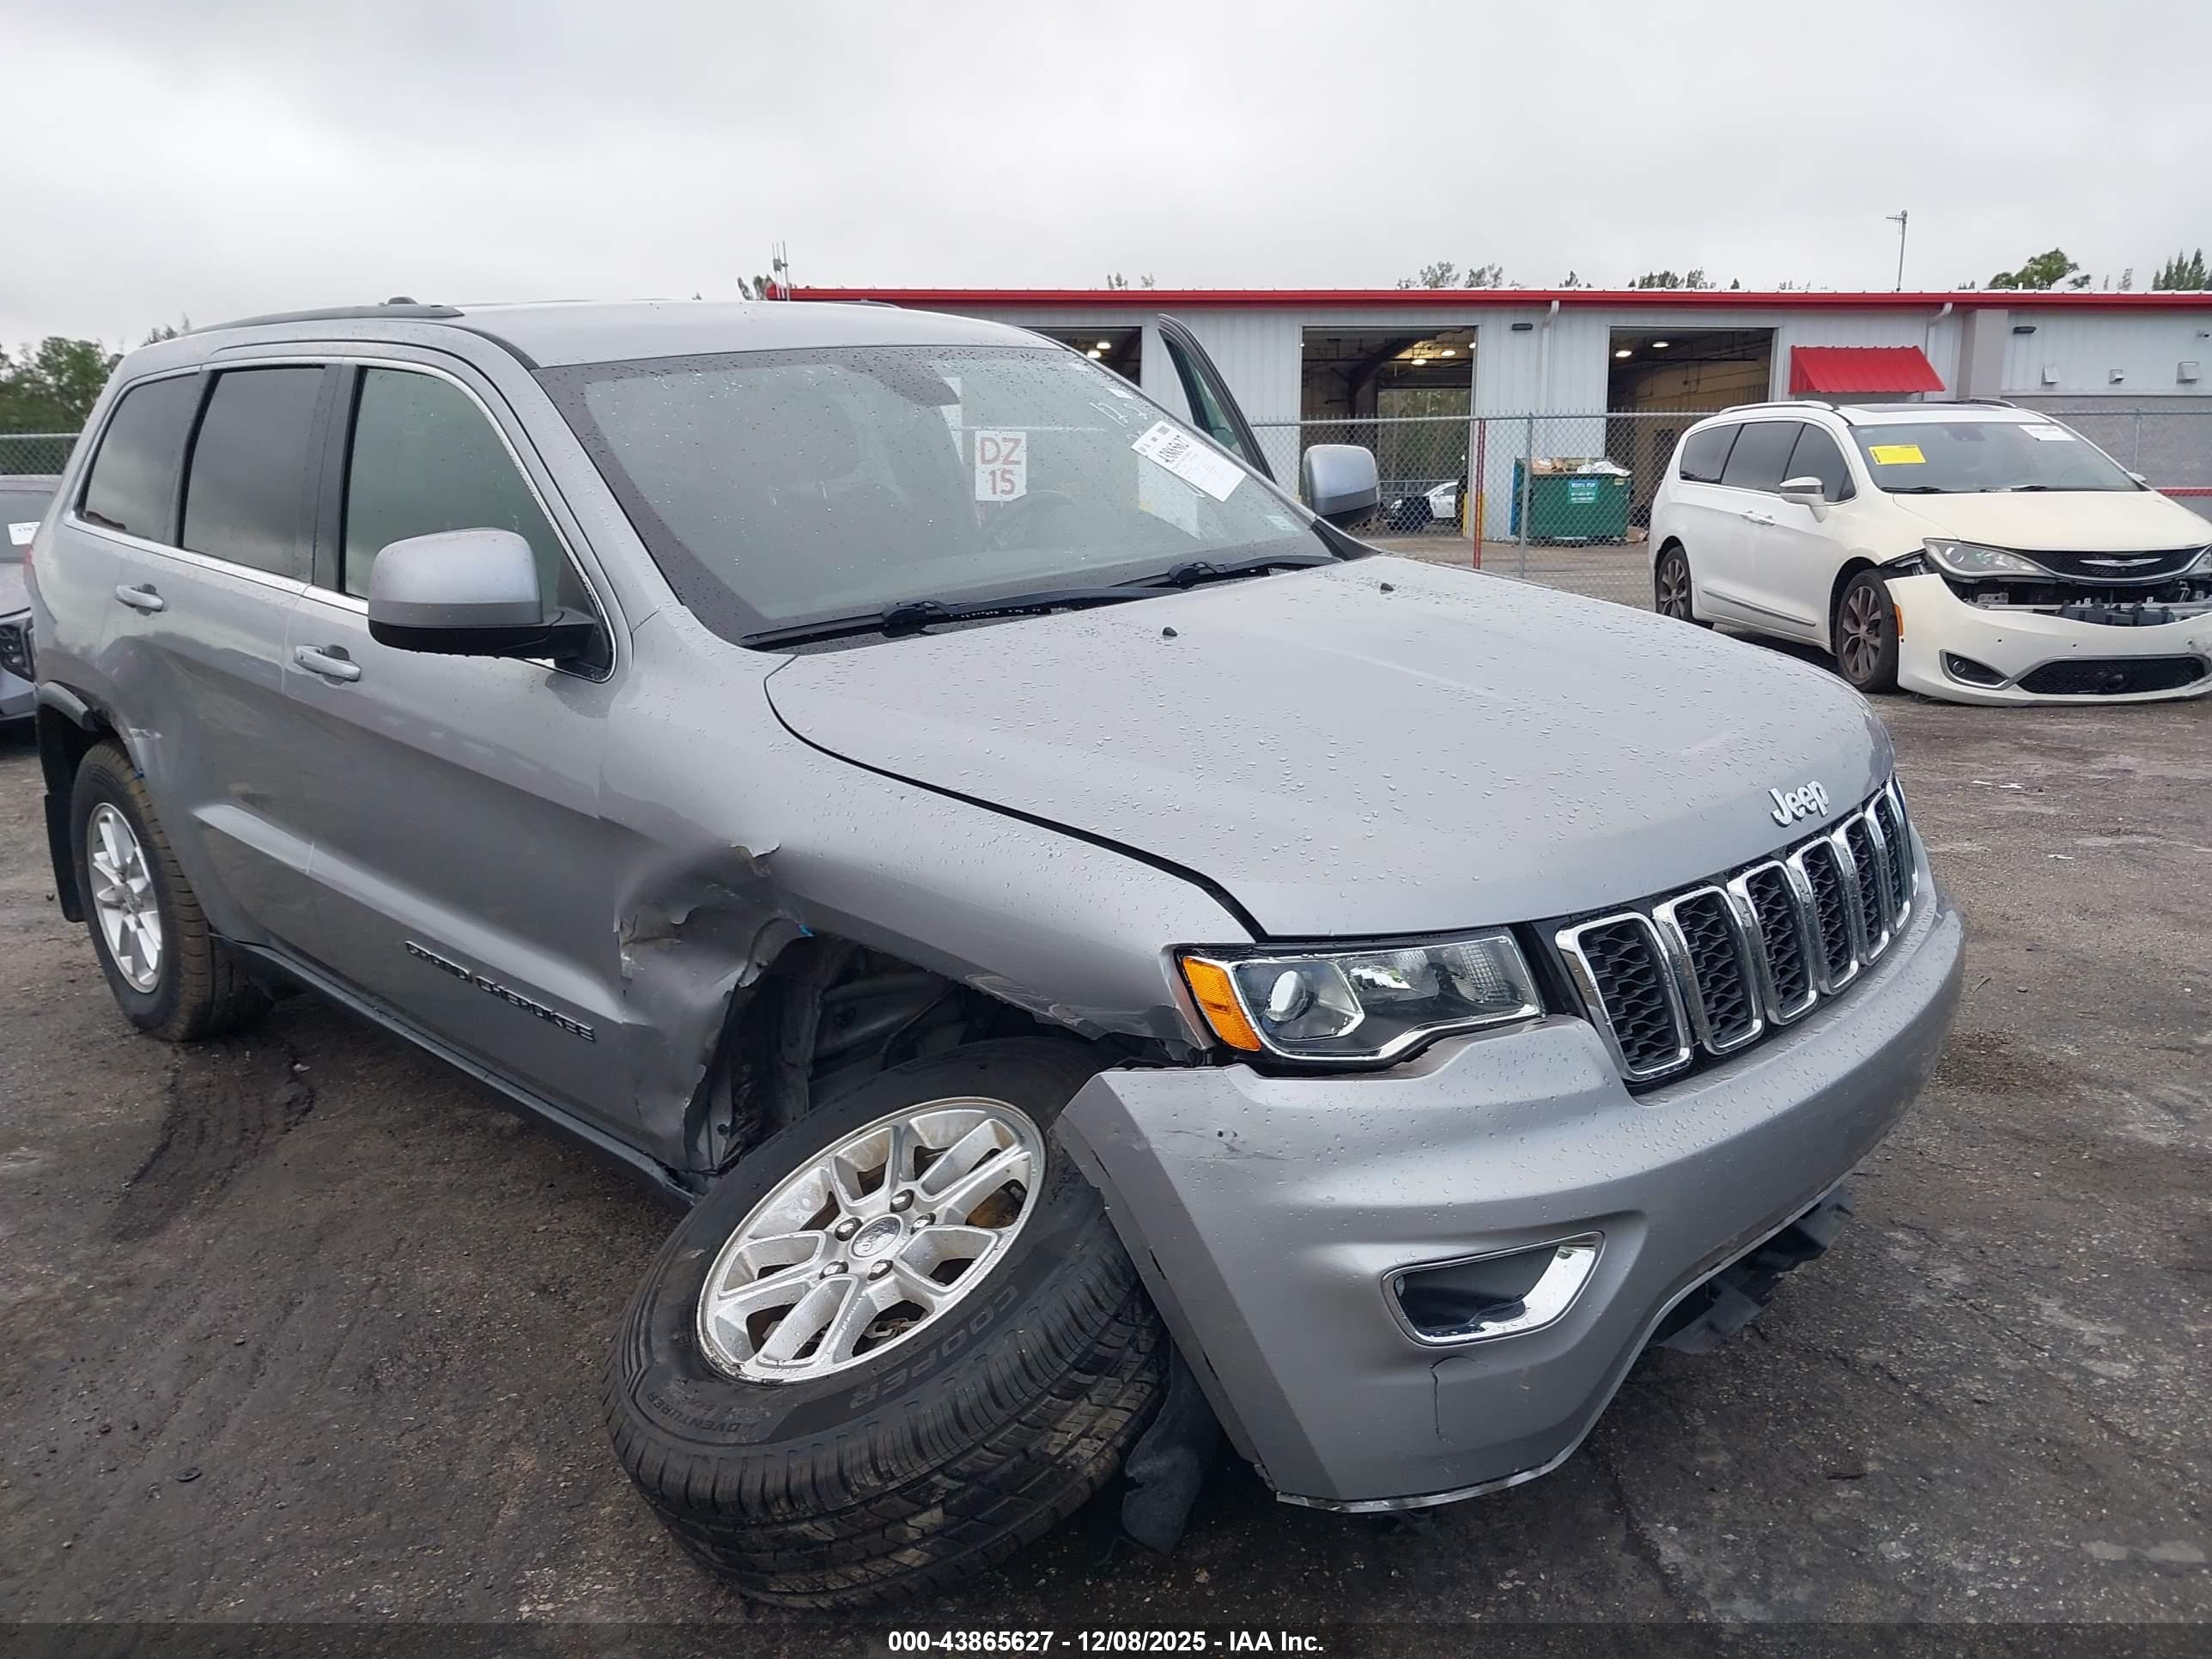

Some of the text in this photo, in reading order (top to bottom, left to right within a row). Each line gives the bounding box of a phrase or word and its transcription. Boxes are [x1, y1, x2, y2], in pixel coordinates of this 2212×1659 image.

[980, 436, 1022, 465] DZ
[988, 467, 1016, 495] 15
[1767, 780, 1830, 828] Jeep
[476, 975, 596, 1042] CHEROKEE
[849, 1285, 1018, 1410] COOPER
